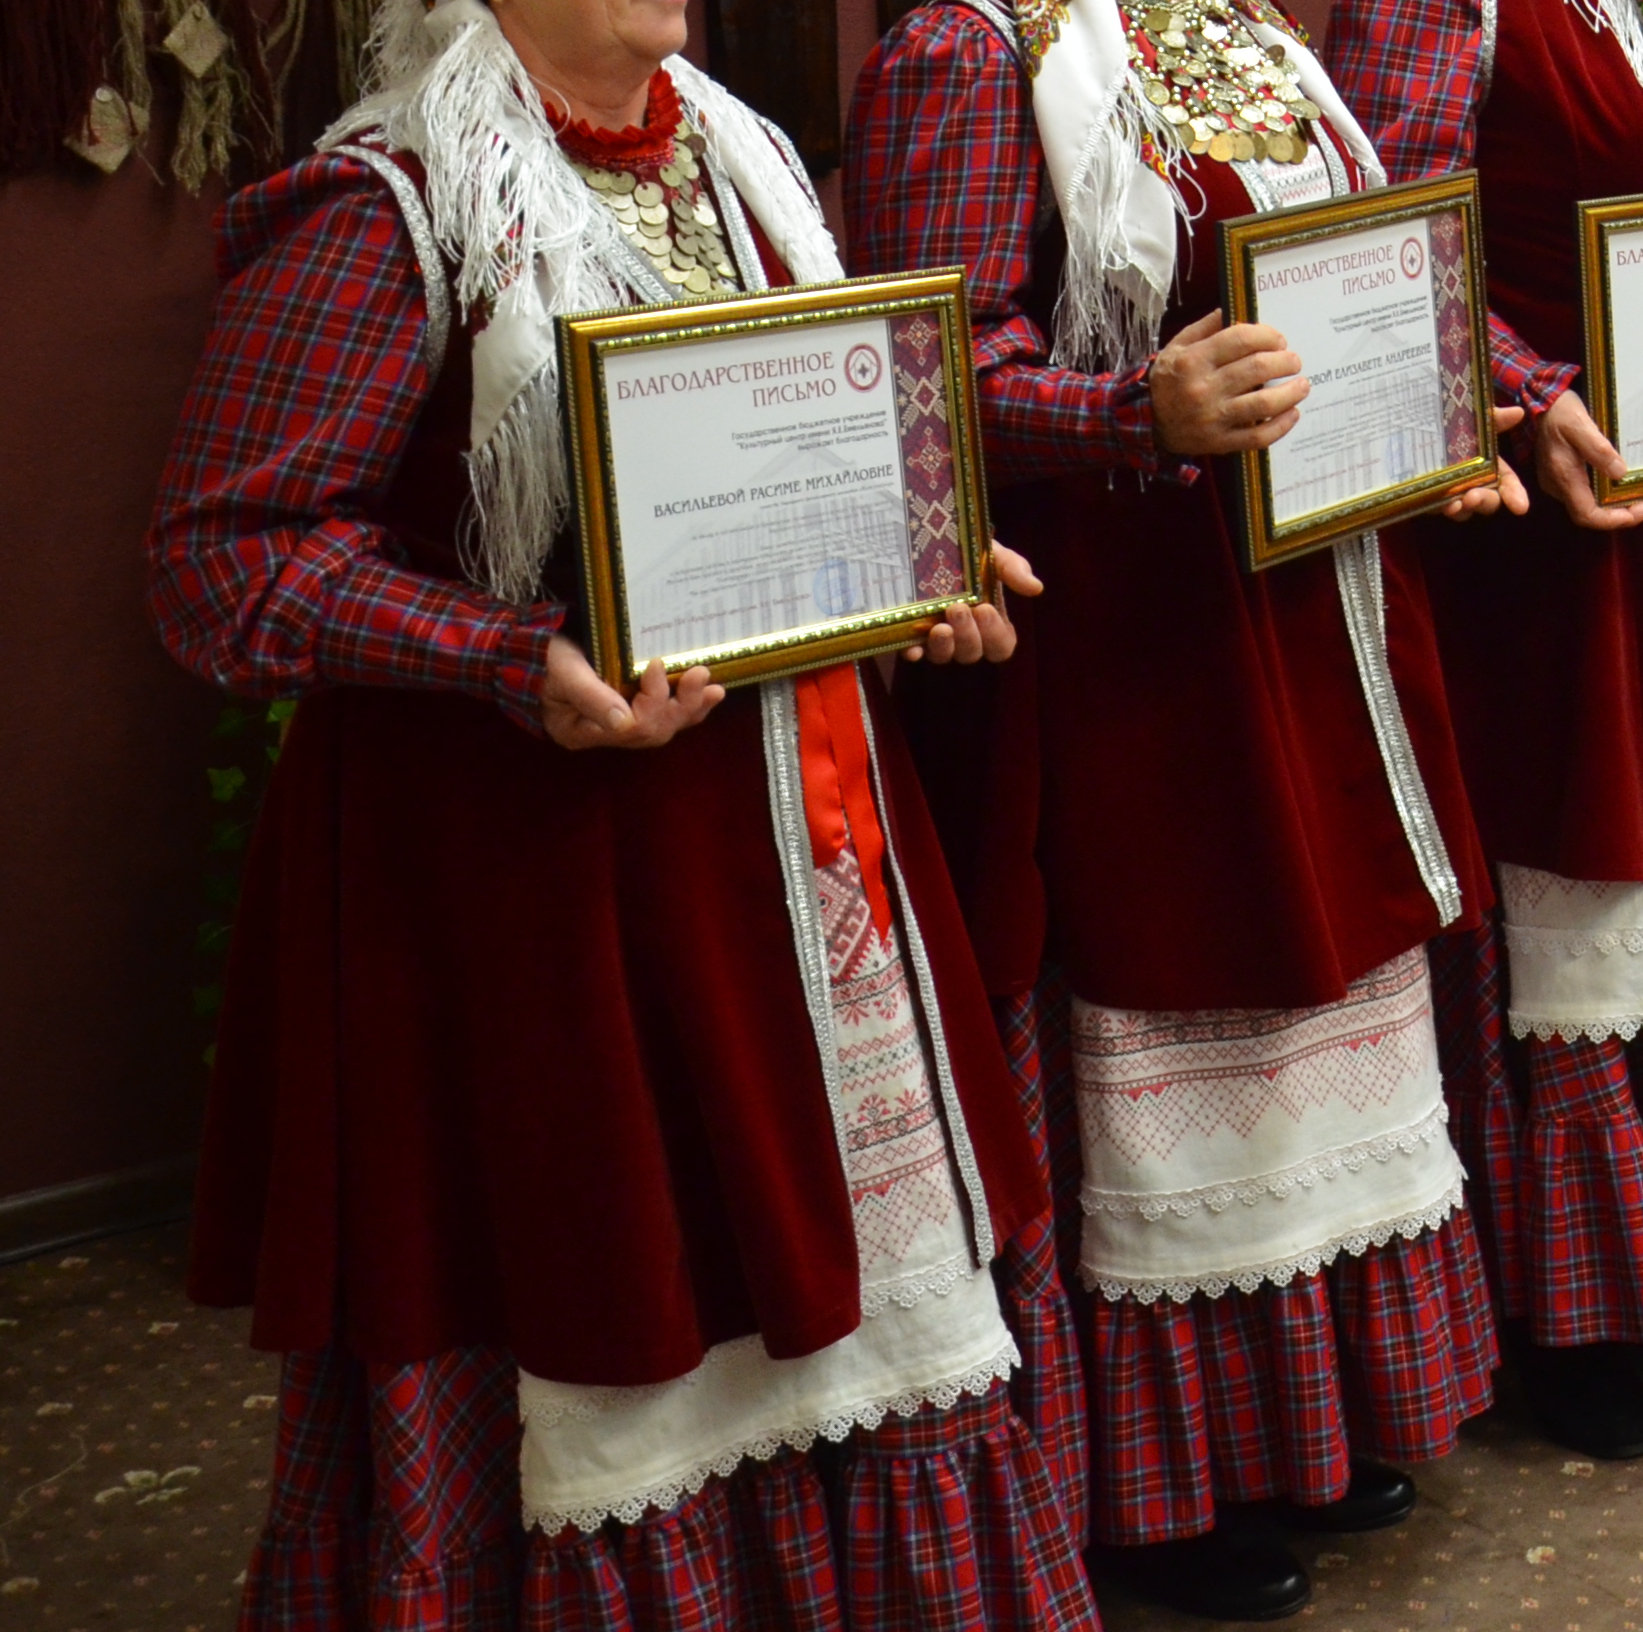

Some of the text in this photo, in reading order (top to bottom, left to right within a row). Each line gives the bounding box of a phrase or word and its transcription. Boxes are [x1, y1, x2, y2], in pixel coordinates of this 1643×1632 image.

[1257, 244, 1393, 292] БЛАГОДАРСТВЕННОЕ
[1342, 268, 1396, 296] ПИСЬМО
[617, 351, 835, 400] БЛАГОДАРСТВЕННОЕ
[1335, 357, 1382, 380] ЕЛИЗАВЕТЕ
[1385, 343, 1432, 365] АНДРЕЕВНЕ
[753, 378, 837, 408] ПИСЬМО
[653, 464, 894, 518] ВАСИЛЬЕВОЙ РАСИМЕ МИХАЙЛОВНЕ
